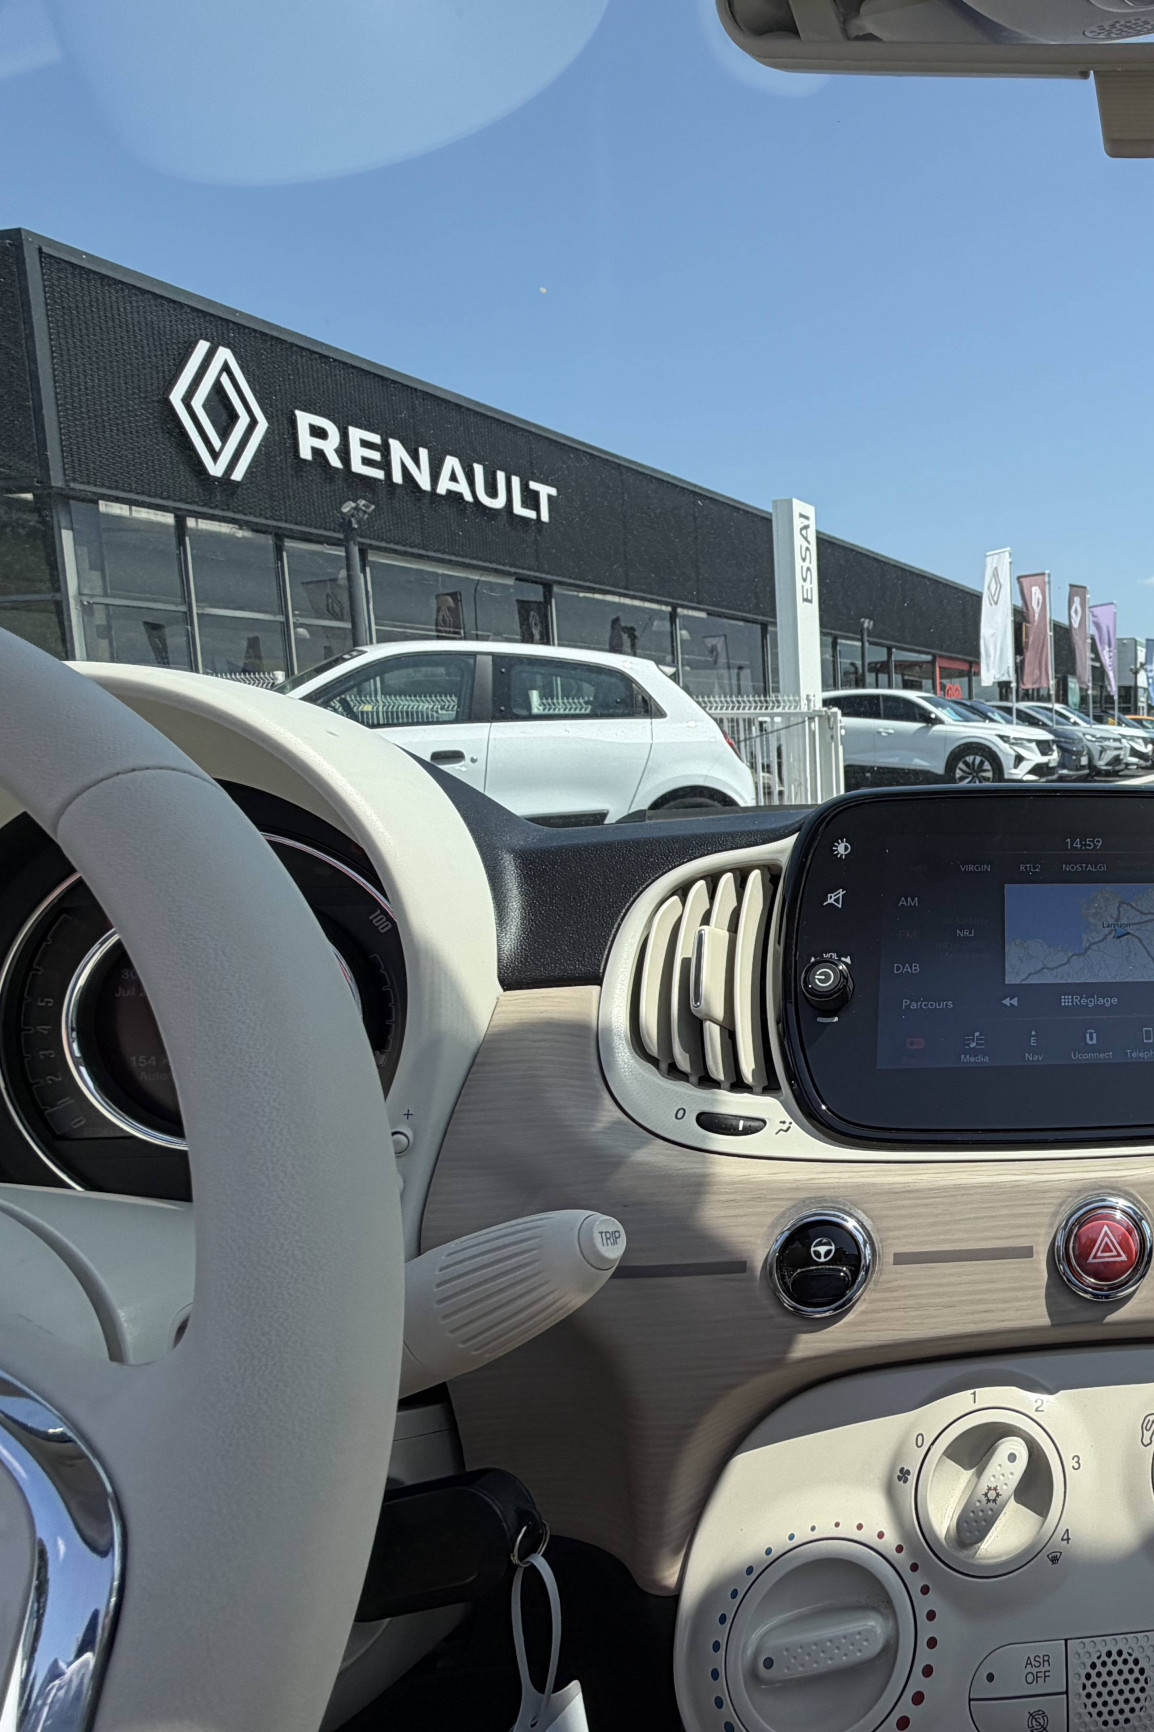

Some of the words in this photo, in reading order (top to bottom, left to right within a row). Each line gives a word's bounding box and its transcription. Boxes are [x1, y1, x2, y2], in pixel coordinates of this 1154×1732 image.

[294, 408, 558, 523] RENAULT
[799, 512, 813, 604] ESSAI
[1065, 838, 1102, 850] 14:59
[959, 864, 991, 872] VIRGIN
[1019, 864, 1041, 872] RTL2
[1062, 864, 1107, 872] NOSTALGI
[898, 897, 919, 907] AM
[368, 908, 392, 934] 100
[956, 929, 975, 937] NRJ
[823, 952, 839, 960] VOL
[893, 963, 920, 974] DAB
[38, 997, 53, 1007] 5
[902, 999, 954, 1010] Parcours
[1073, 994, 1118, 1008] Réglage
[40, 1049, 55, 1059] 3
[960, 1053, 989, 1063] Média
[1025, 1052, 1043, 1061] Nav
[1071, 1050, 1113, 1060] Uconnect
[130, 1055, 157, 1067] 154
[46, 1072, 63, 1084] 2
[674, 1107, 687, 1120] 0
[72, 1116, 87, 1128] 0
[598, 1230, 622, 1248] TRIP
[970, 1390, 977, 1404] 1
[1034, 1398, 1045, 1414] 2
[915, 1433, 925, 1448] 0
[1072, 1455, 1082, 1471] 3
[1060, 1529, 1071, 1545] 4
[1024, 1654, 1051, 1669] ASR
[1025, 1669, 1051, 1685] OFF
